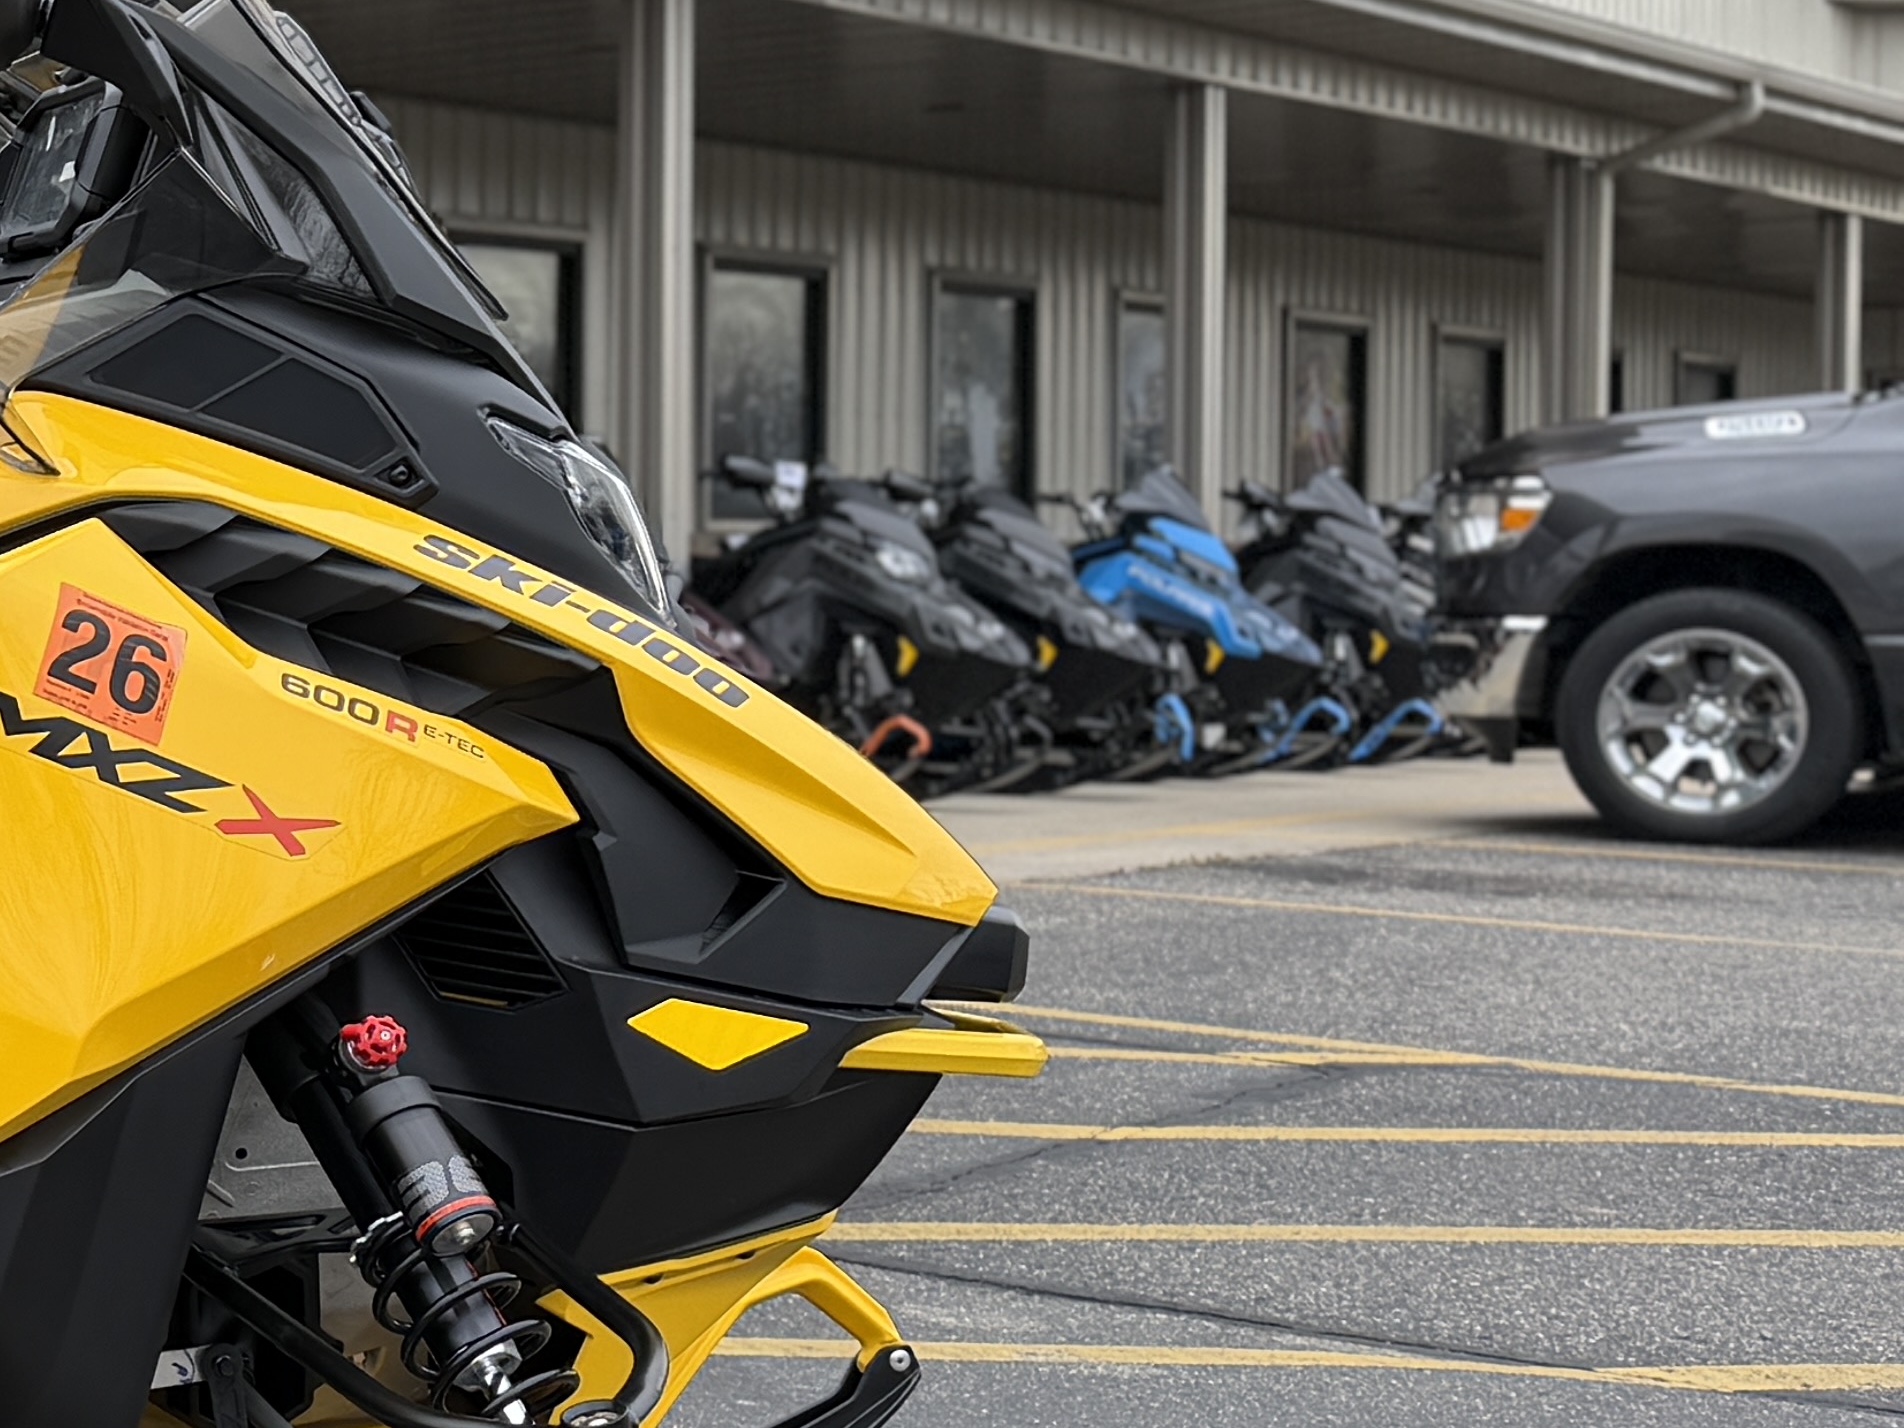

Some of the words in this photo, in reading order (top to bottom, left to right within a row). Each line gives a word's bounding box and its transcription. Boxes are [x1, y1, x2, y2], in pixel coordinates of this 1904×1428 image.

[47, 609, 167, 714] 26
[423, 724, 485, 759] E-TEC
[215, 783, 341, 857] X
